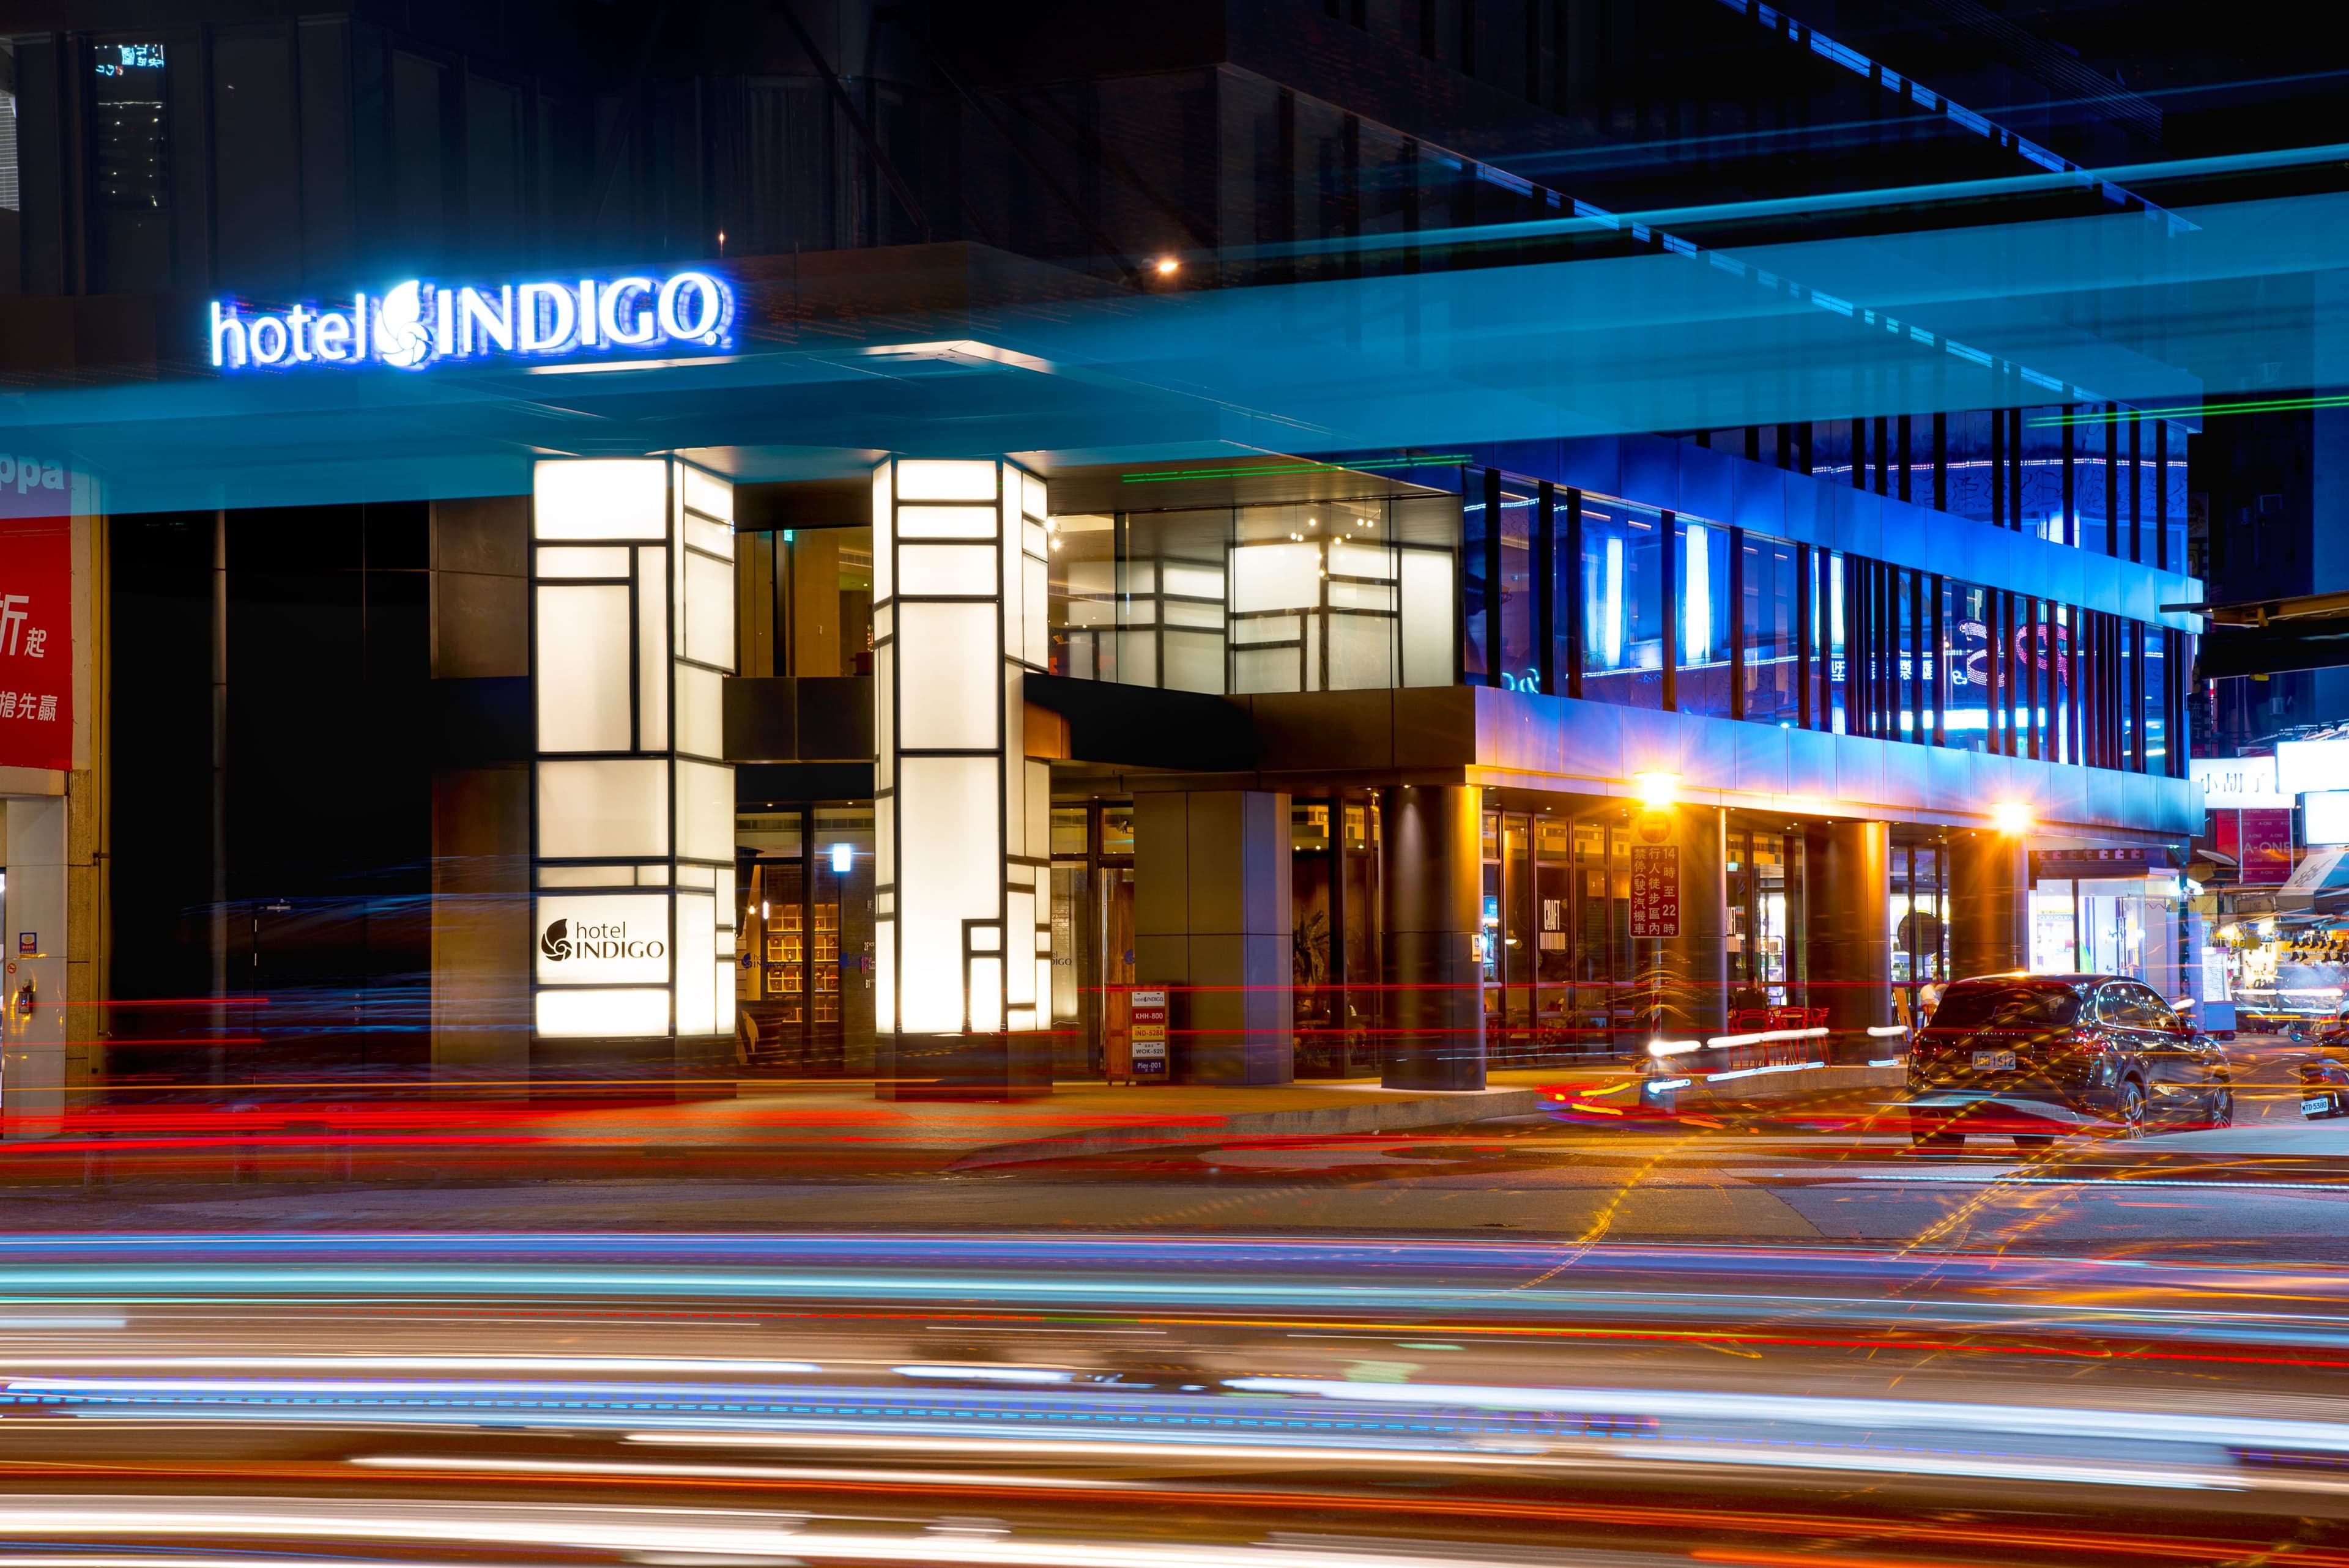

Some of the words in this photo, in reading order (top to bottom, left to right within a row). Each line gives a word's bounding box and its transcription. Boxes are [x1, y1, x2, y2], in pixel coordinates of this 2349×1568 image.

[211, 292, 366, 367] hotel
[438, 272, 724, 355] INDIGO
[0, 690, 58, 722] 搶先贏
[2243, 841, 2290, 854] A-ONE
[1543, 899, 1560, 930] CRAFT
[577, 921, 625, 939] hotel
[577, 941, 664, 959] INDIGO
